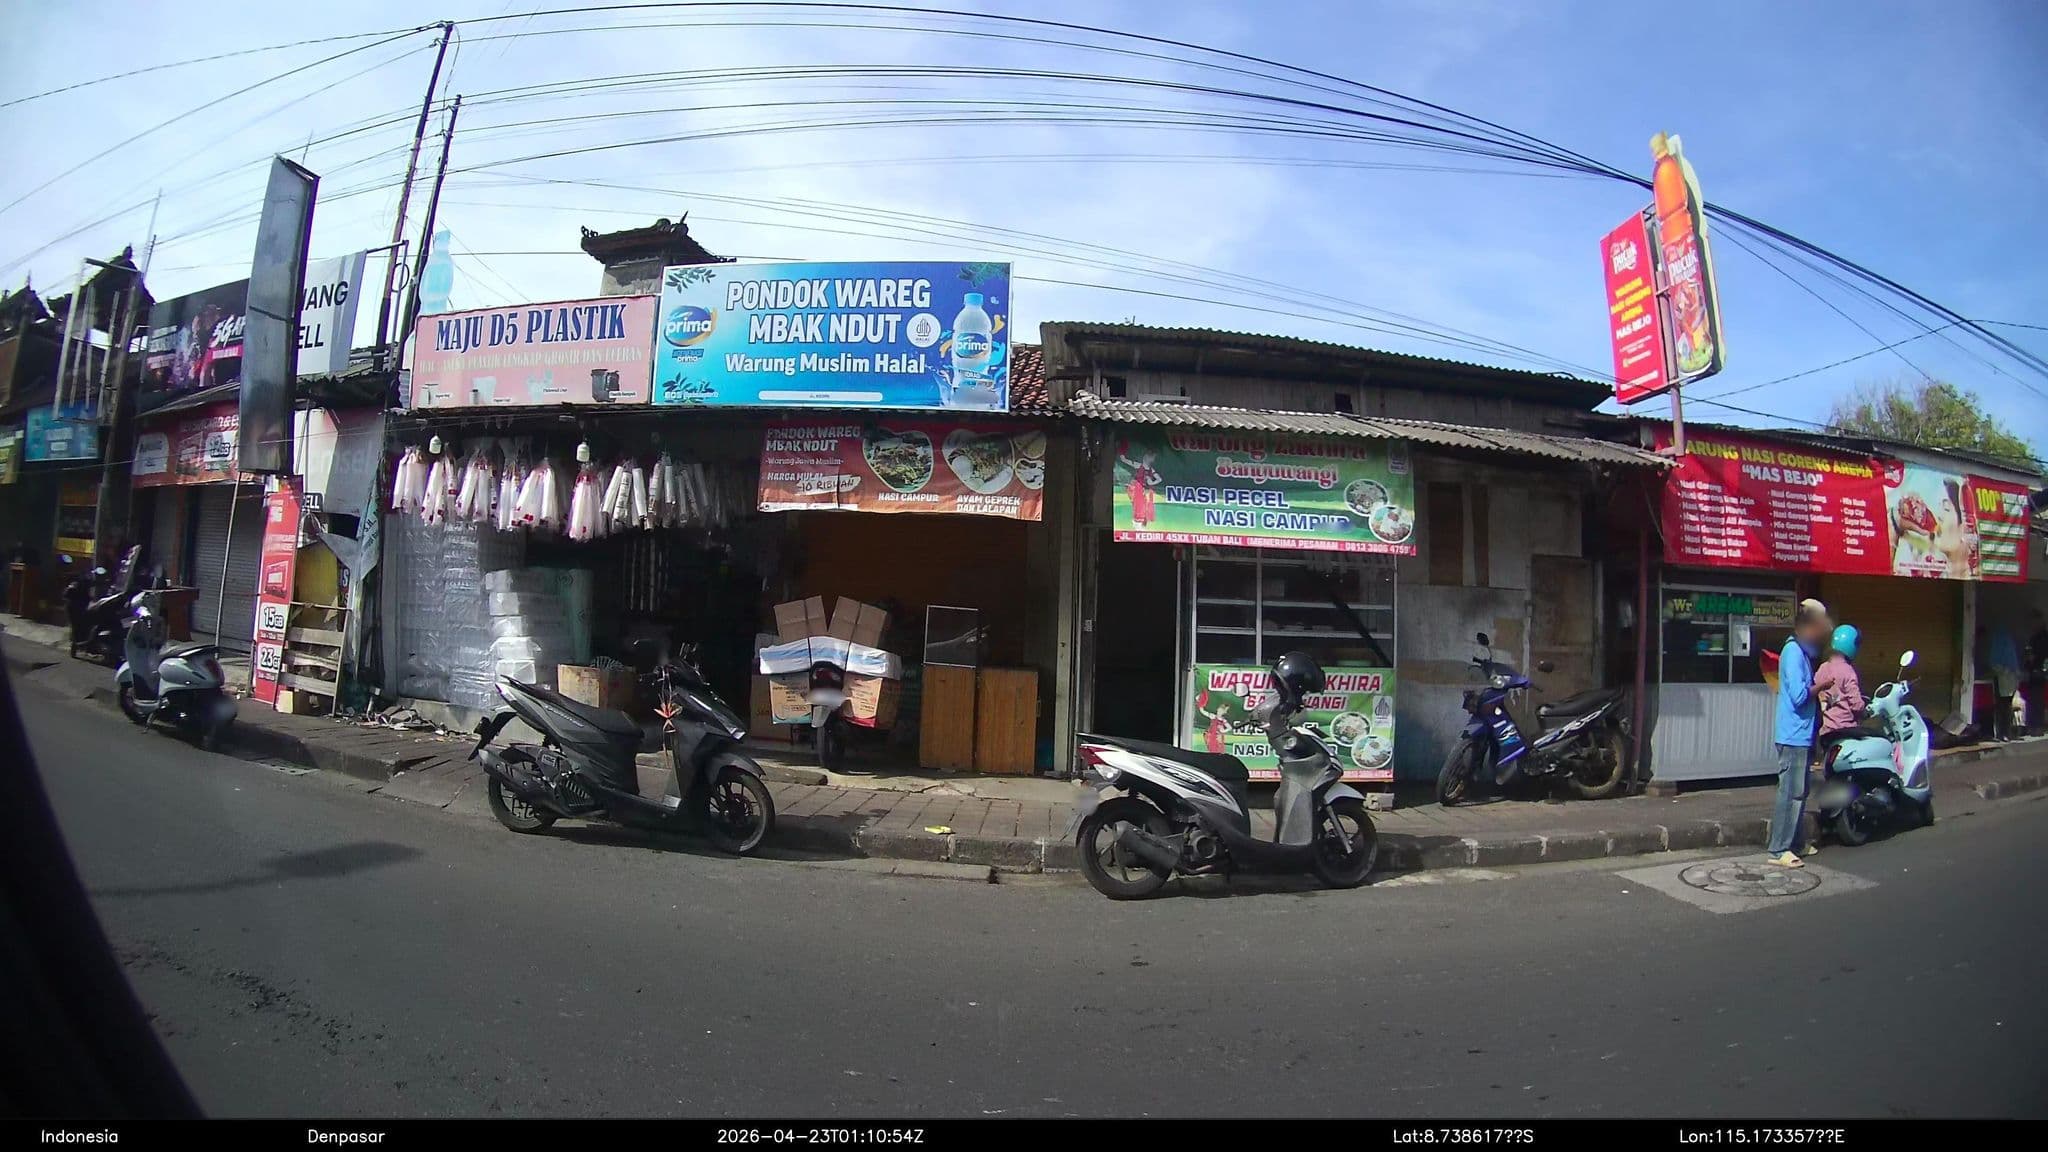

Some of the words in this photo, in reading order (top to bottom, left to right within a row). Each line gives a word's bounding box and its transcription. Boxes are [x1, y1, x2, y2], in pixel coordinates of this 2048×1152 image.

[303, 281, 348, 311] ANG
[726, 278, 830, 311] PONDOK
[834, 278, 931, 308] WAREG
[436, 316, 484, 353] MAJU
[488, 312, 518, 347] D5
[525, 304, 627, 344] PLASTIK
[665, 317, 712, 336] prima
[749, 313, 825, 344] MBAK
[829, 312, 902, 343] NDUT
[297, 324, 324, 350] ELL
[957, 339, 989, 352] prima
[725, 353, 796, 376] Warung
[800, 352, 870, 373] Muslim
[874, 353, 926, 374] Halal
[817, 426, 861, 438] WAREG
[766, 440, 801, 452] MBAK
[803, 440, 838, 452] NDUT
[1670, 437, 1739, 460] ARUNG
[1741, 447, 1775, 465] NASI
[1777, 451, 1832, 473] GORENG
[767, 473, 796, 481] HARGA
[878, 492, 899, 501] NASI
[901, 493, 939, 503] CAMPUR
[956, 494, 983, 504] AYAM
[985, 496, 1021, 505] GEPREK
[1166, 486, 1217, 505] NASI
[1224, 488, 1290, 508] PECEL
[956, 504, 976, 512] DAN
[977, 504, 1018, 514] LALAPAN
[1206, 509, 1256, 527] NASI
[1135, 532, 1164, 542] KEDIRI
[1191, 534, 1221, 544] TUBAN
[1223, 536, 1242, 545] BALI
[1210, 671, 1278, 692] WARUN
[1325, 674, 1381, 694] KHIRA
[1234, 744, 1269, 756] NASI
